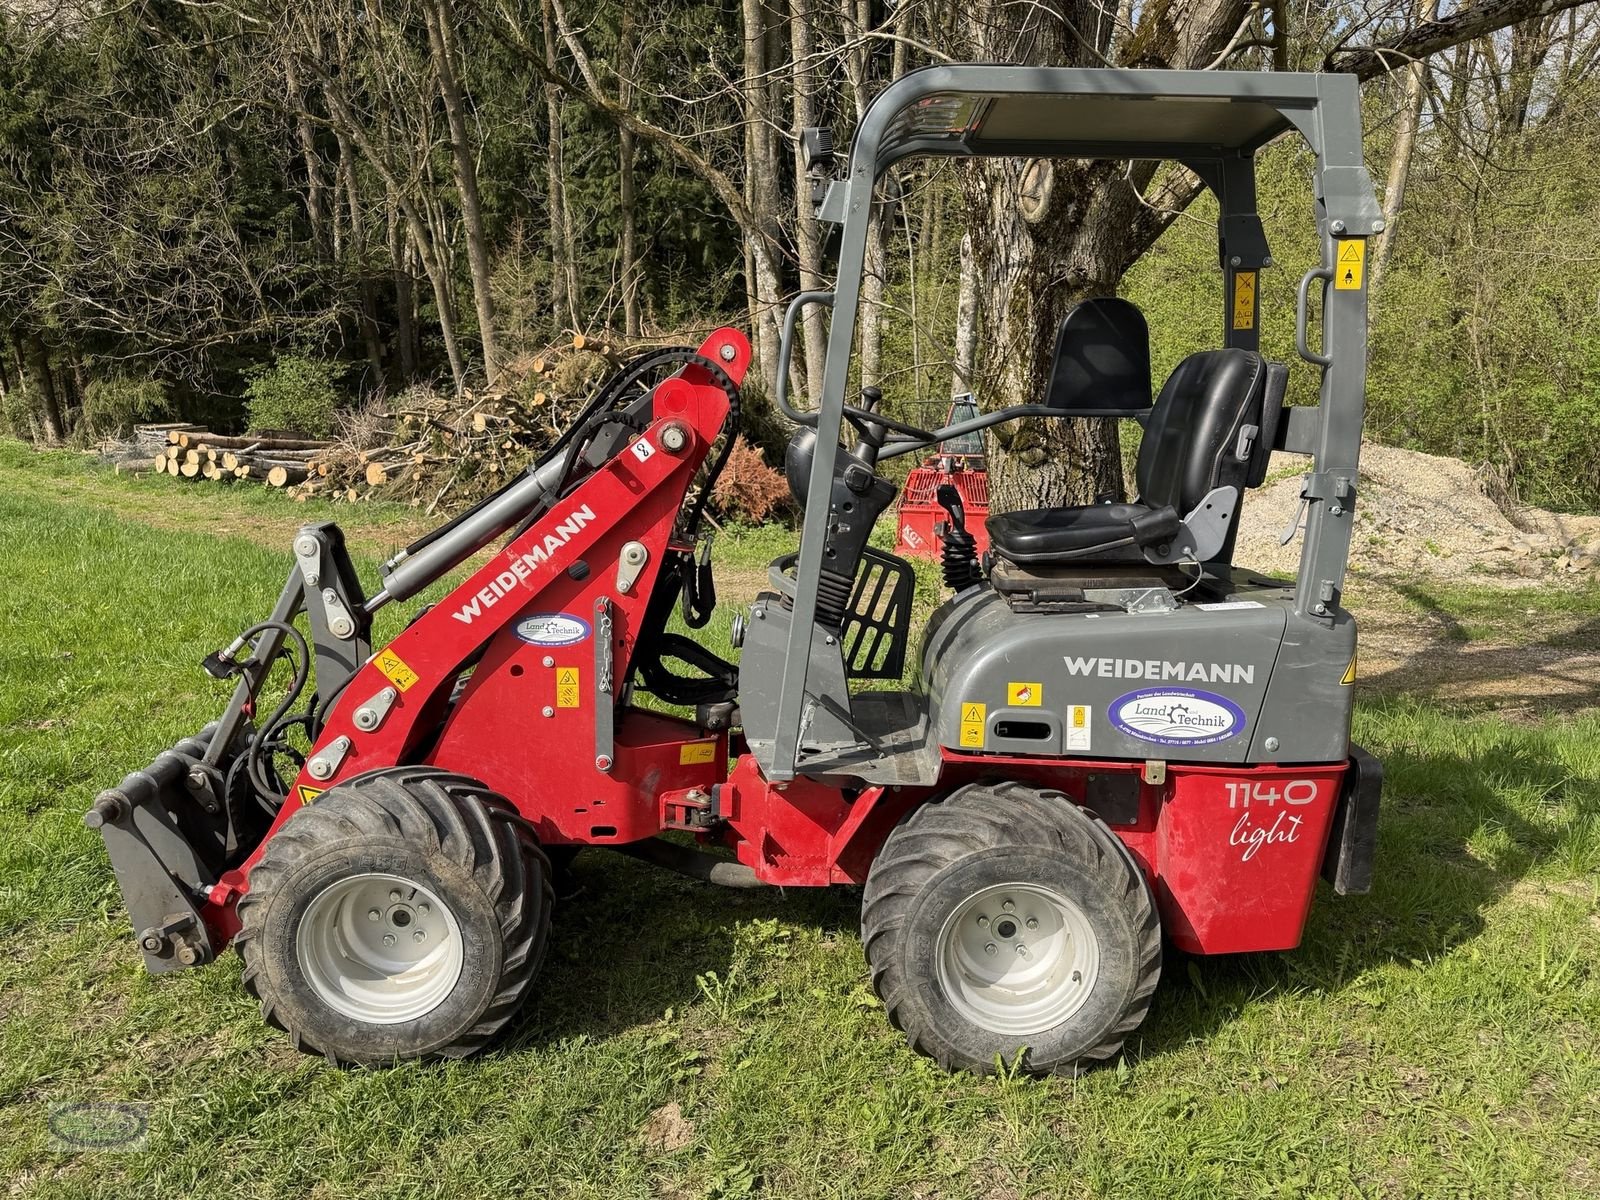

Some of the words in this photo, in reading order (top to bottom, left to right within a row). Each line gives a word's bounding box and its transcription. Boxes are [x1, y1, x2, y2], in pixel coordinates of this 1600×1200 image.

[452, 503, 597, 625] WEIDEMANN
[526, 622, 545, 630] Land
[1063, 656, 1255, 684] WEIDEMANN
[1135, 703, 1167, 716] Land
[1177, 714, 1226, 728] Technik
[1225, 780, 1318, 808] 1140
[1230, 810, 1304, 862] light
